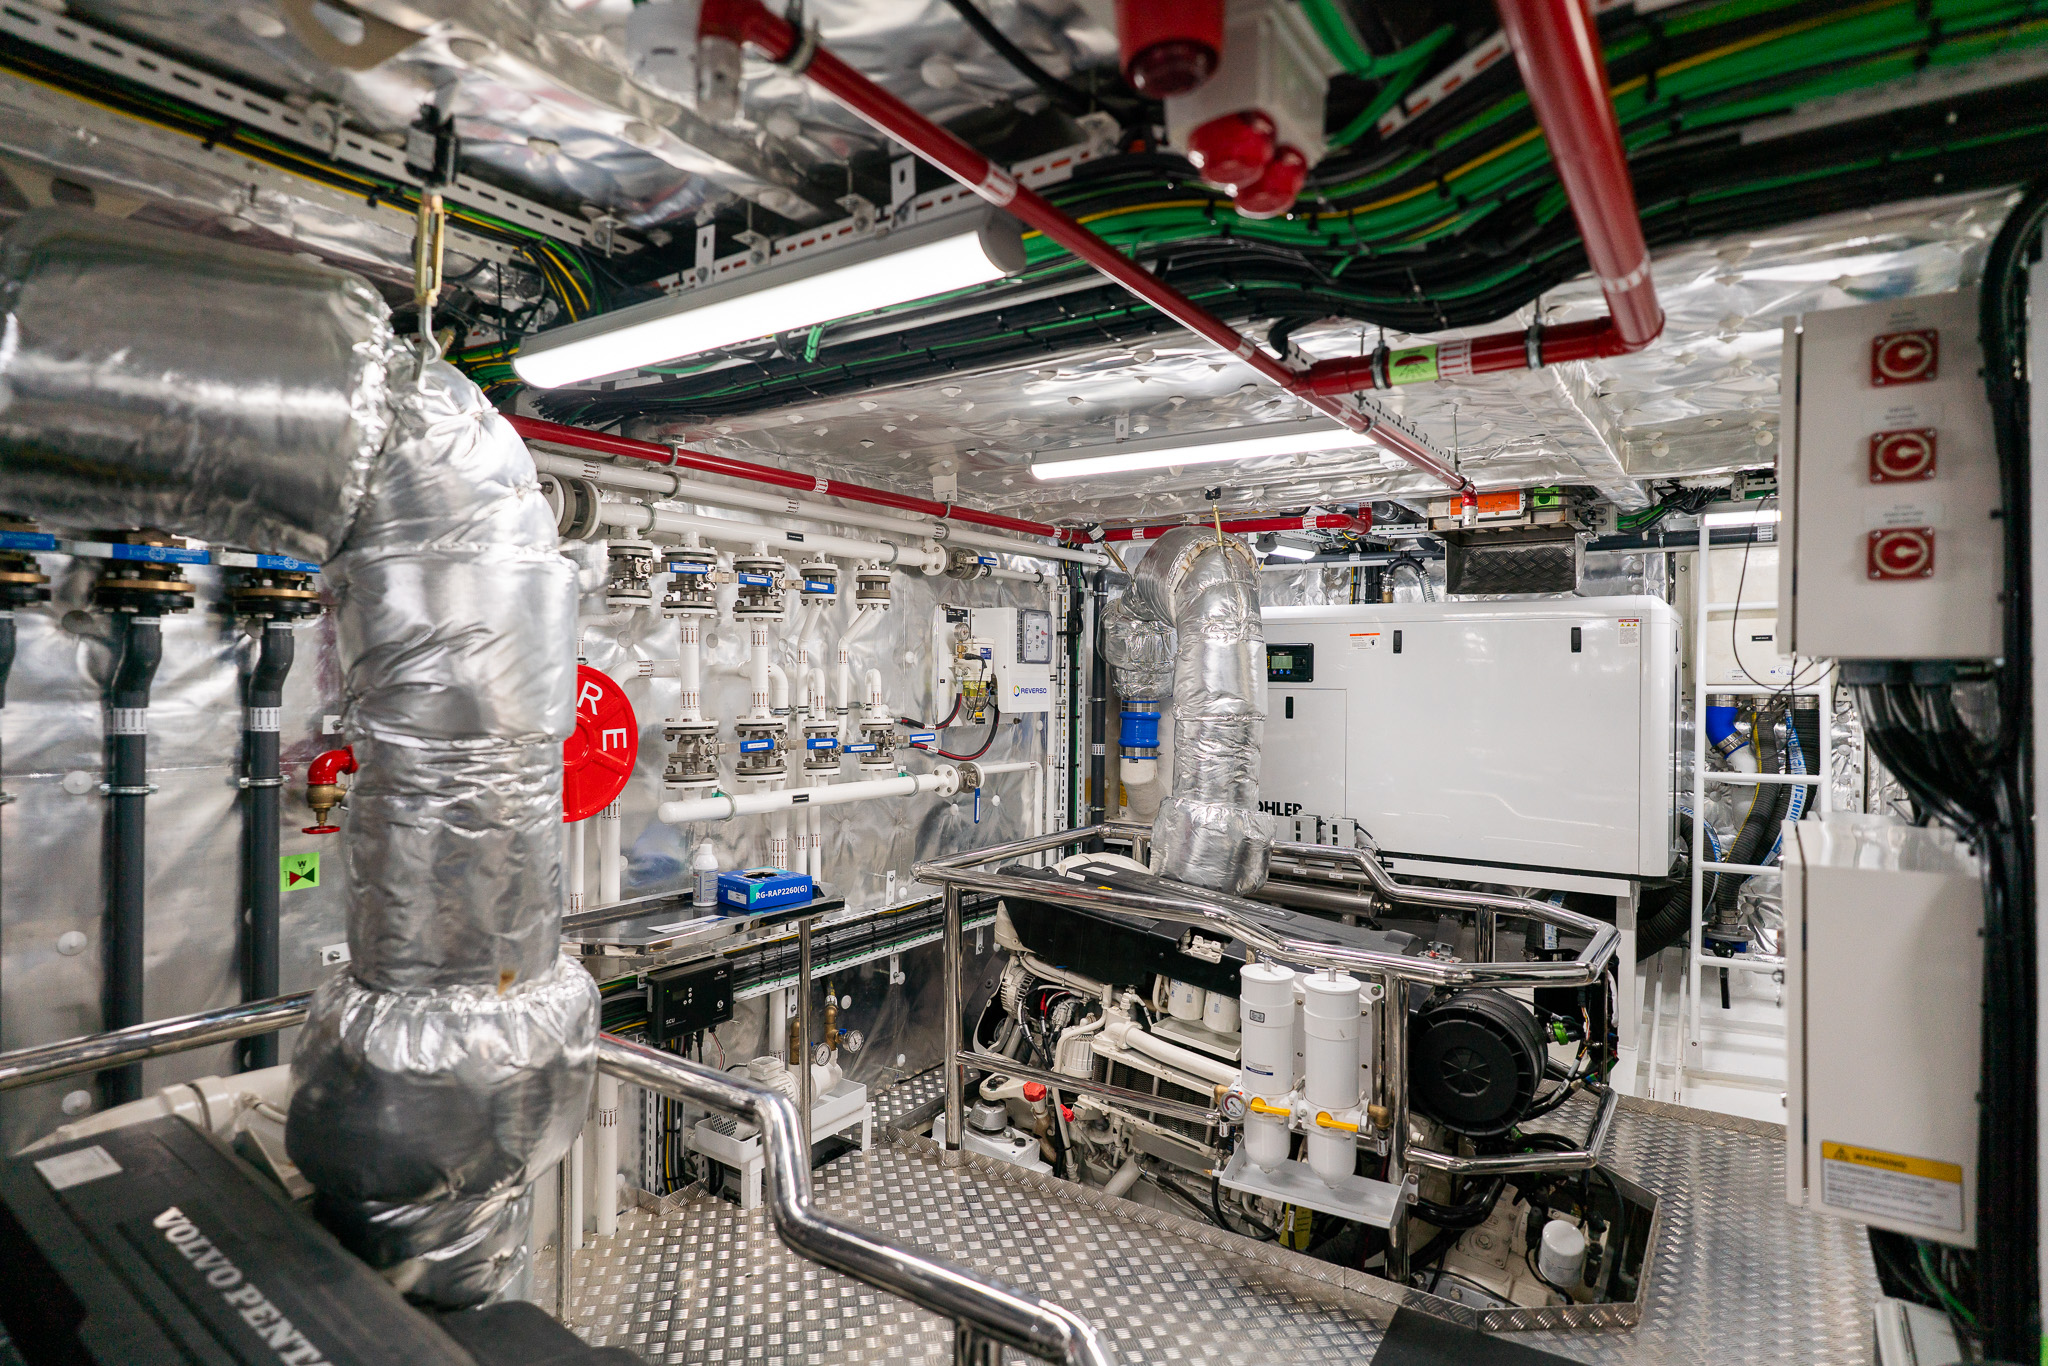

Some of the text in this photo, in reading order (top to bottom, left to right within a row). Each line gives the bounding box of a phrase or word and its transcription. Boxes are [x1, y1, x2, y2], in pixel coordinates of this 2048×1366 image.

[1020, 686, 1047, 695] REVERSO
[577, 680, 627, 752] RE
[1258, 800, 1303, 817] HLER
[297, 860, 307, 868] W
[755, 884, 808, 900] RG-RAP2260(G)
[1158, 880, 1287, 917] VOLVO PENTA
[665, 1017, 676, 1025] SCU
[153, 1206, 335, 1366] VOLVO PENT
